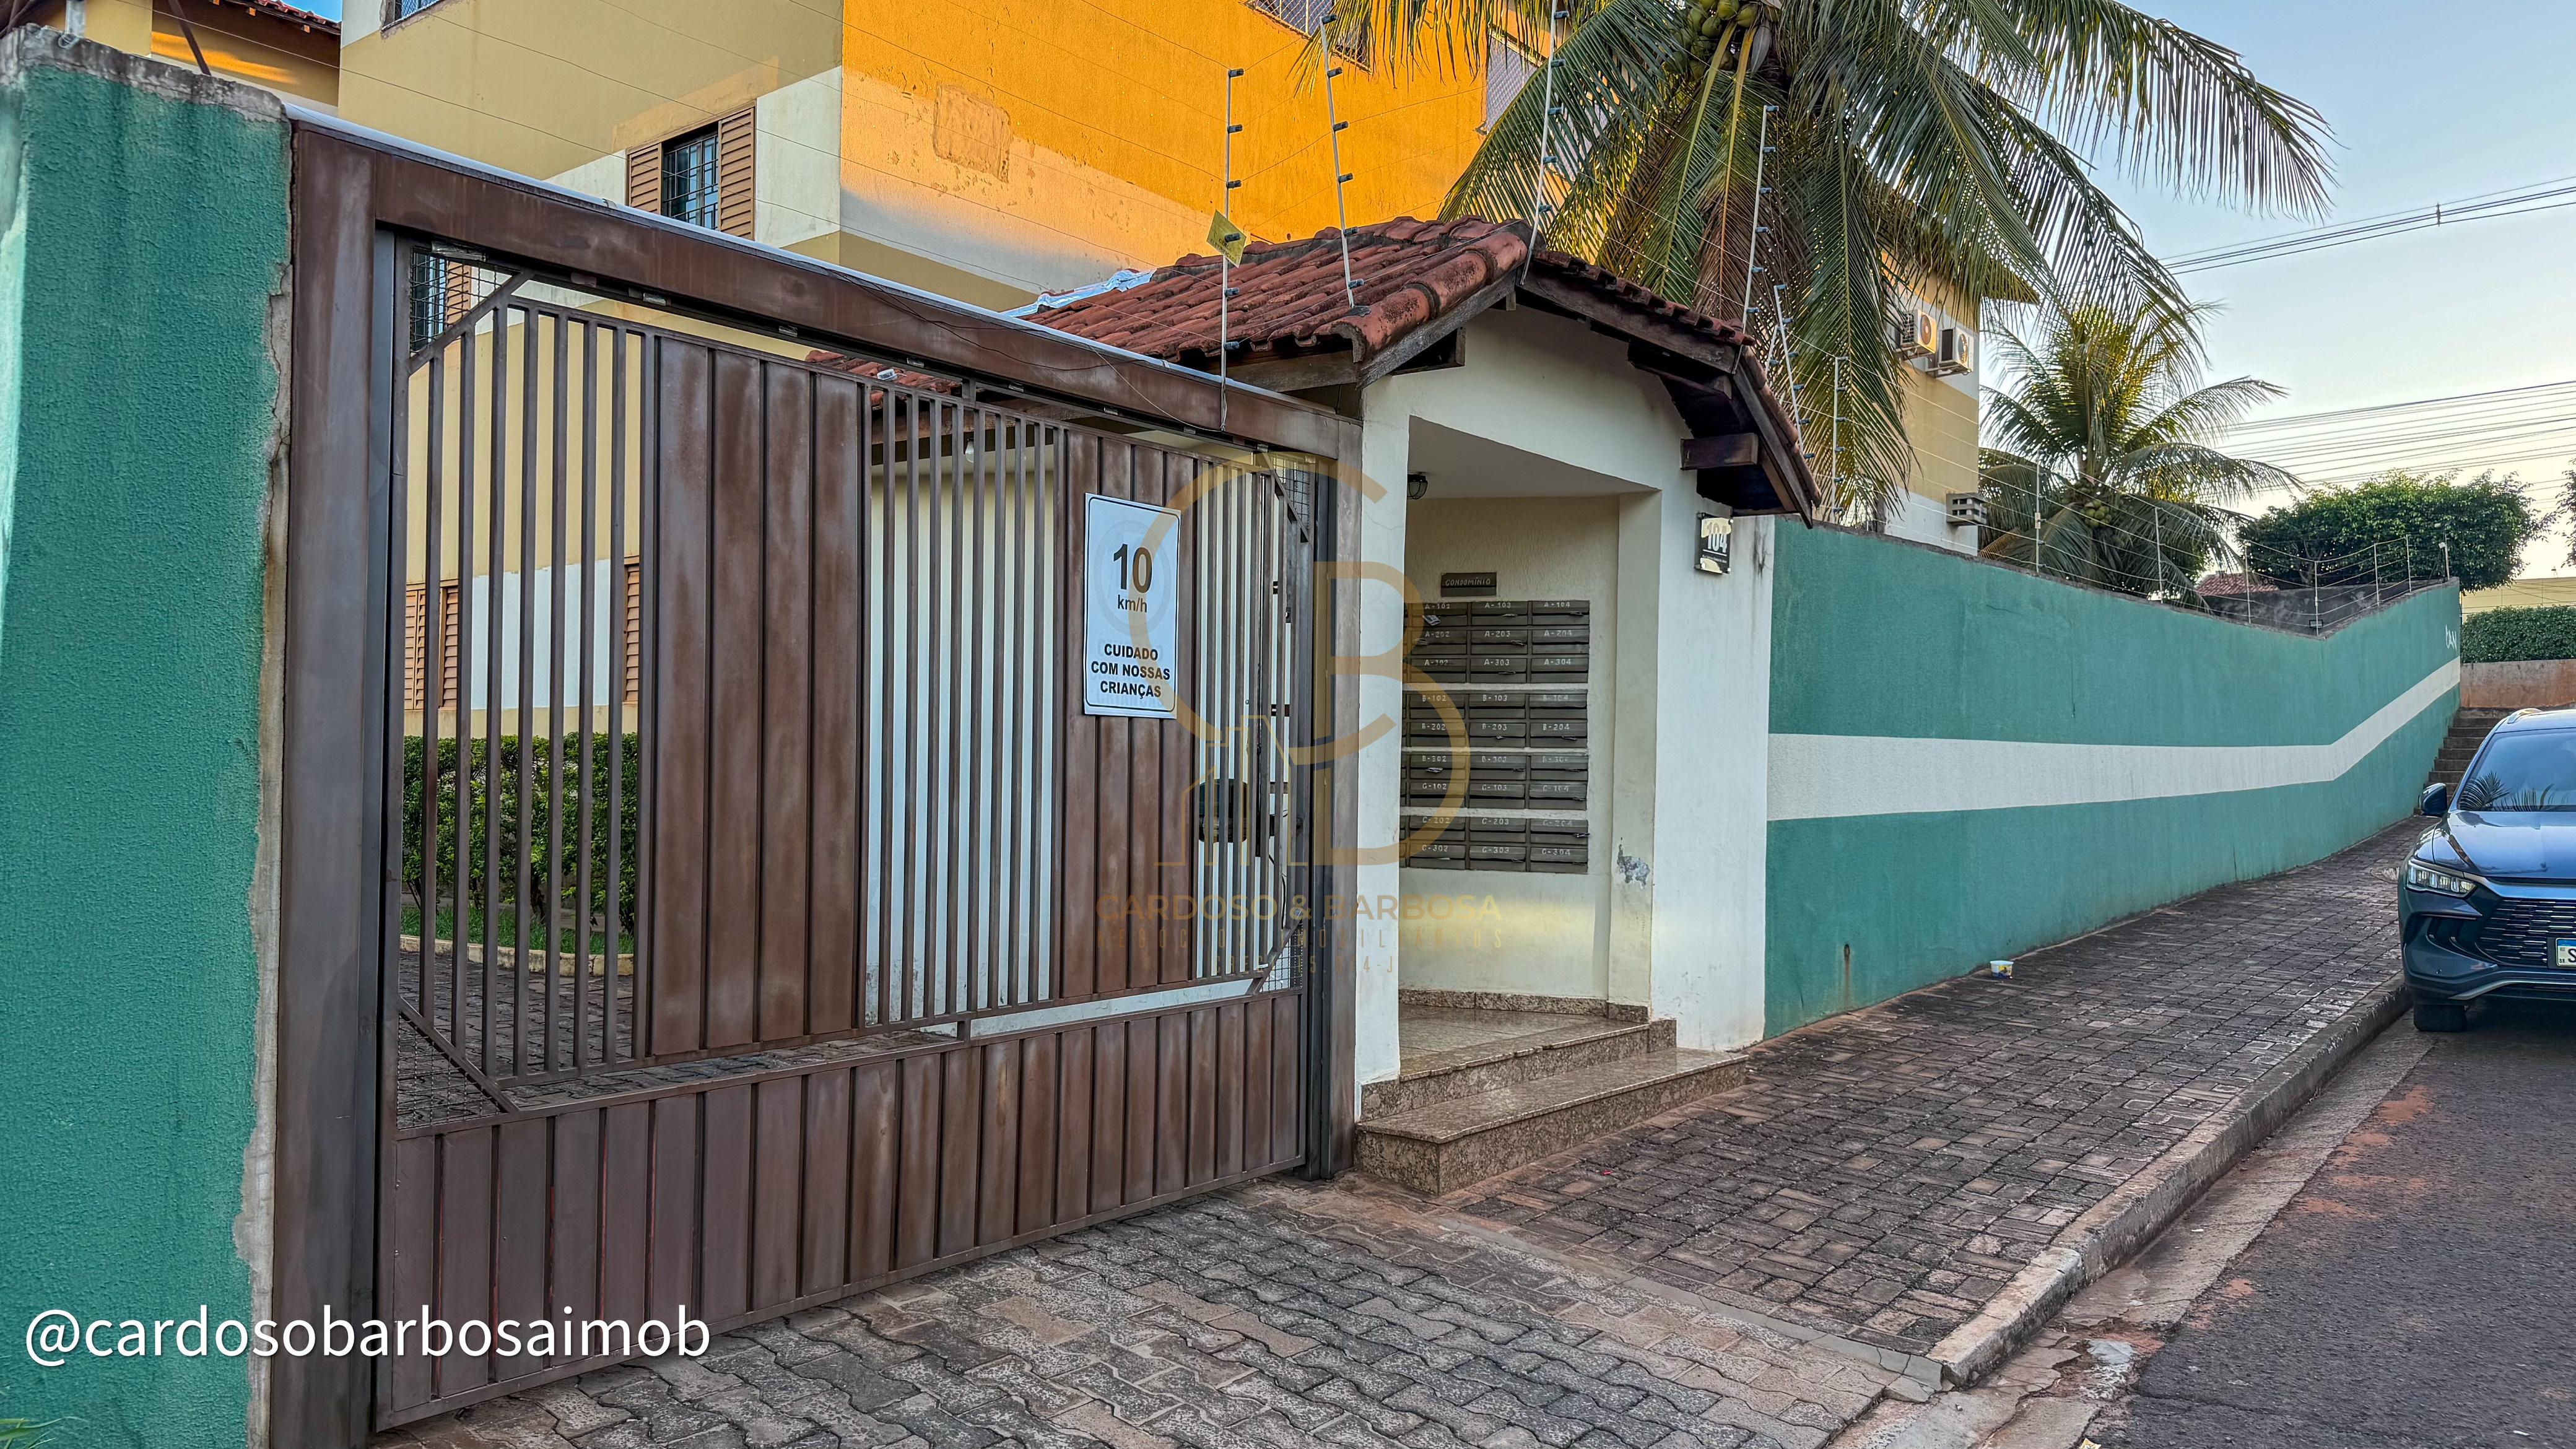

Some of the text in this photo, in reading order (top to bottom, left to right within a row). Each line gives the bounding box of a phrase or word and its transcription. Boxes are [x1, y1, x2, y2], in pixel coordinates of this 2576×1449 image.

[1113, 543, 1152, 594] 10
[1445, 577, 1491, 586] CONDOMÍNIO
[1117, 594, 1147, 613] km/h
[1104, 643, 1158, 661] CUIDADO
[1091, 661, 1170, 681] COM NOSSAS
[1100, 681, 1162, 698] CRIANÇAS
